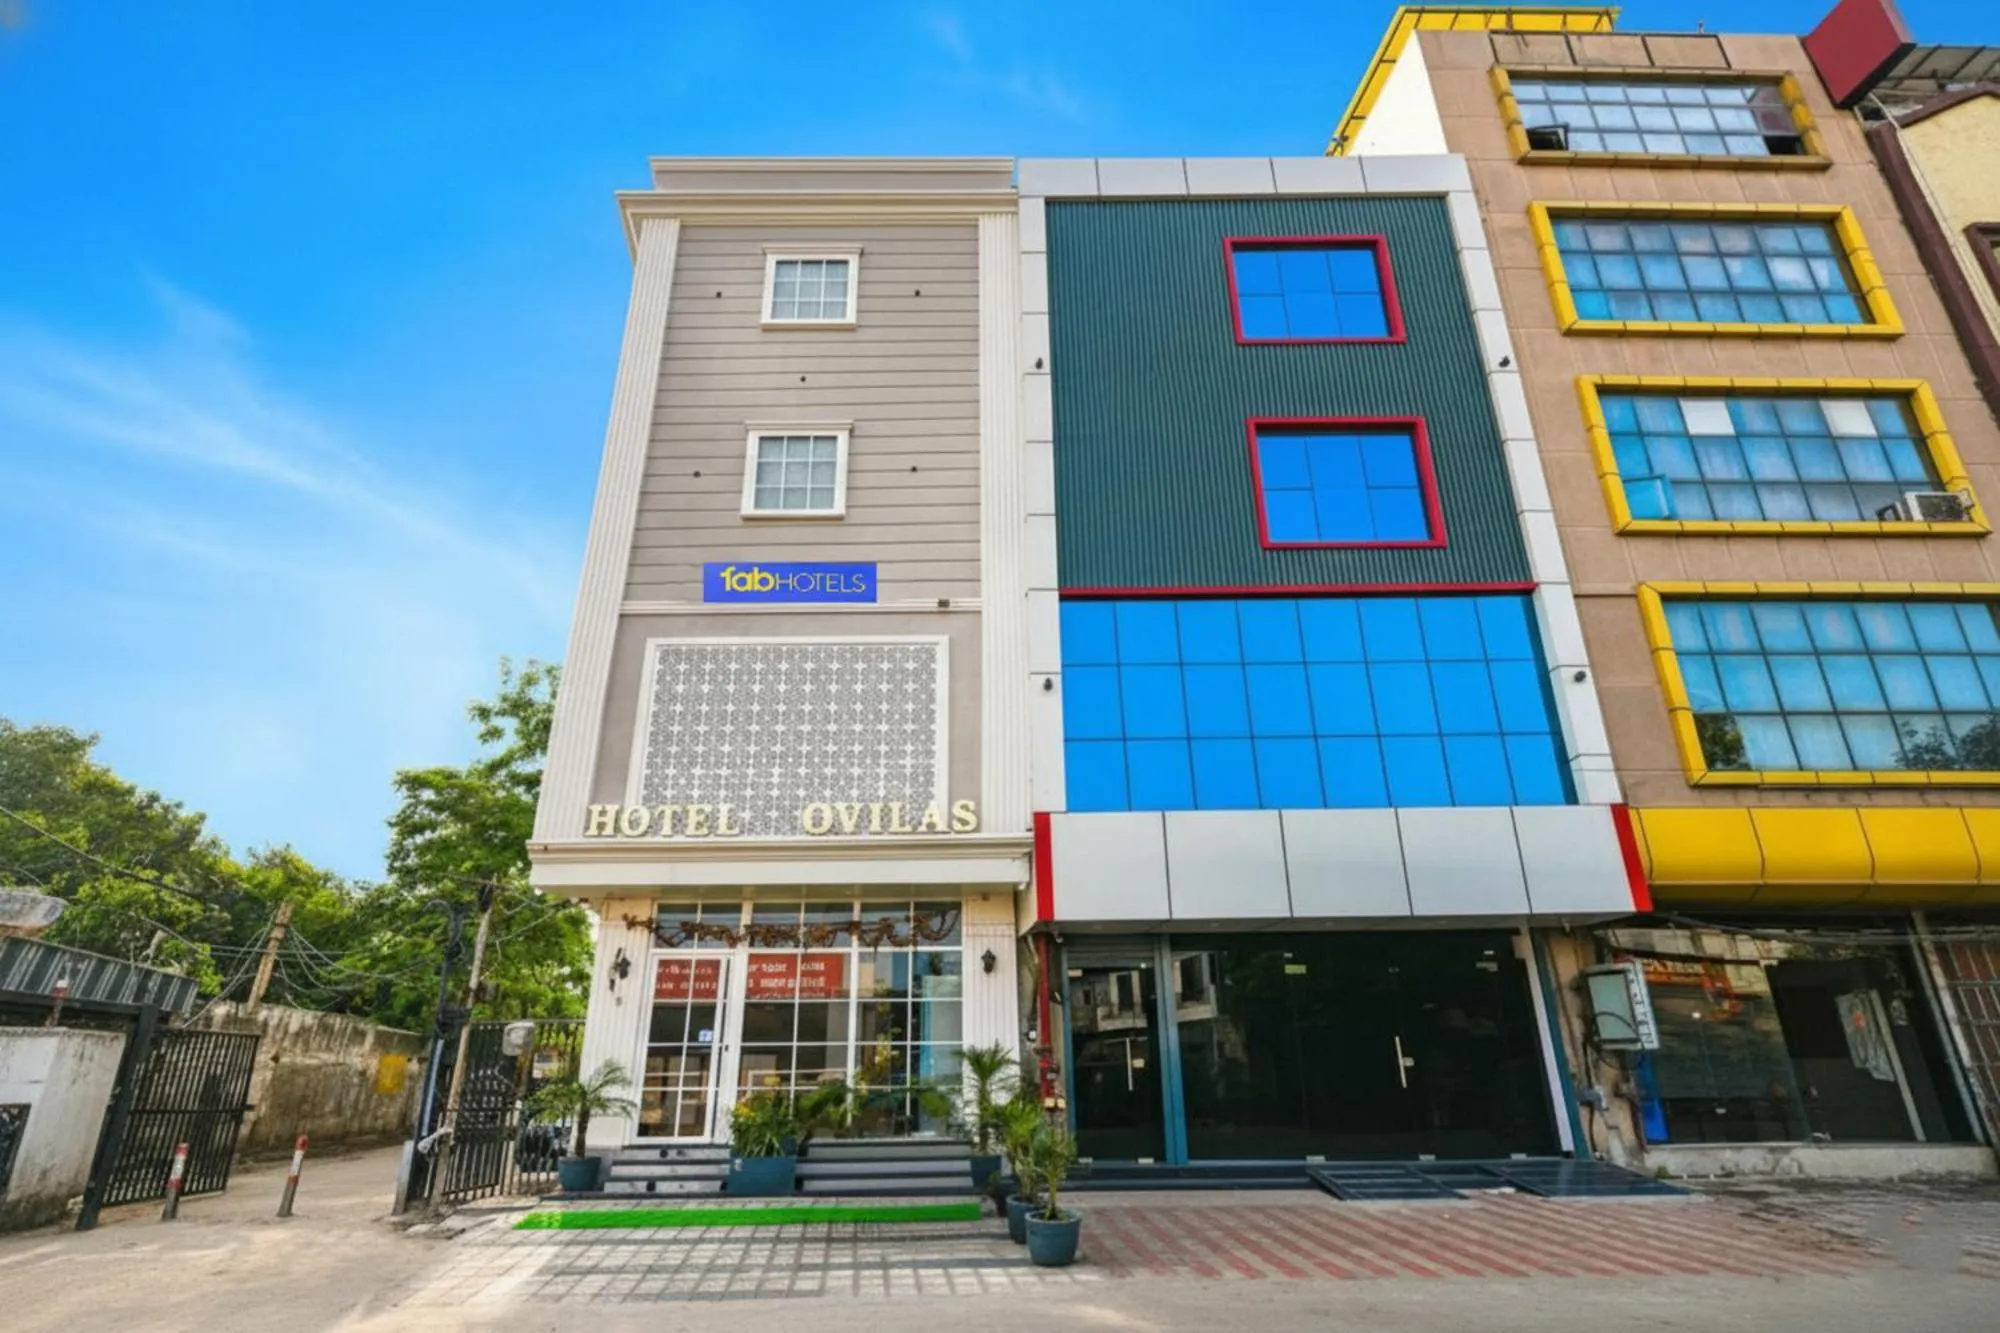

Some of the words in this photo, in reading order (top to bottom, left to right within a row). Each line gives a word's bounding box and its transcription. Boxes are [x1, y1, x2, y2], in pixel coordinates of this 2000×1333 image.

[720, 566, 866, 592] fabHOTELS
[583, 803, 740, 836] HOTEL
[802, 799, 978, 834] OVILAS
